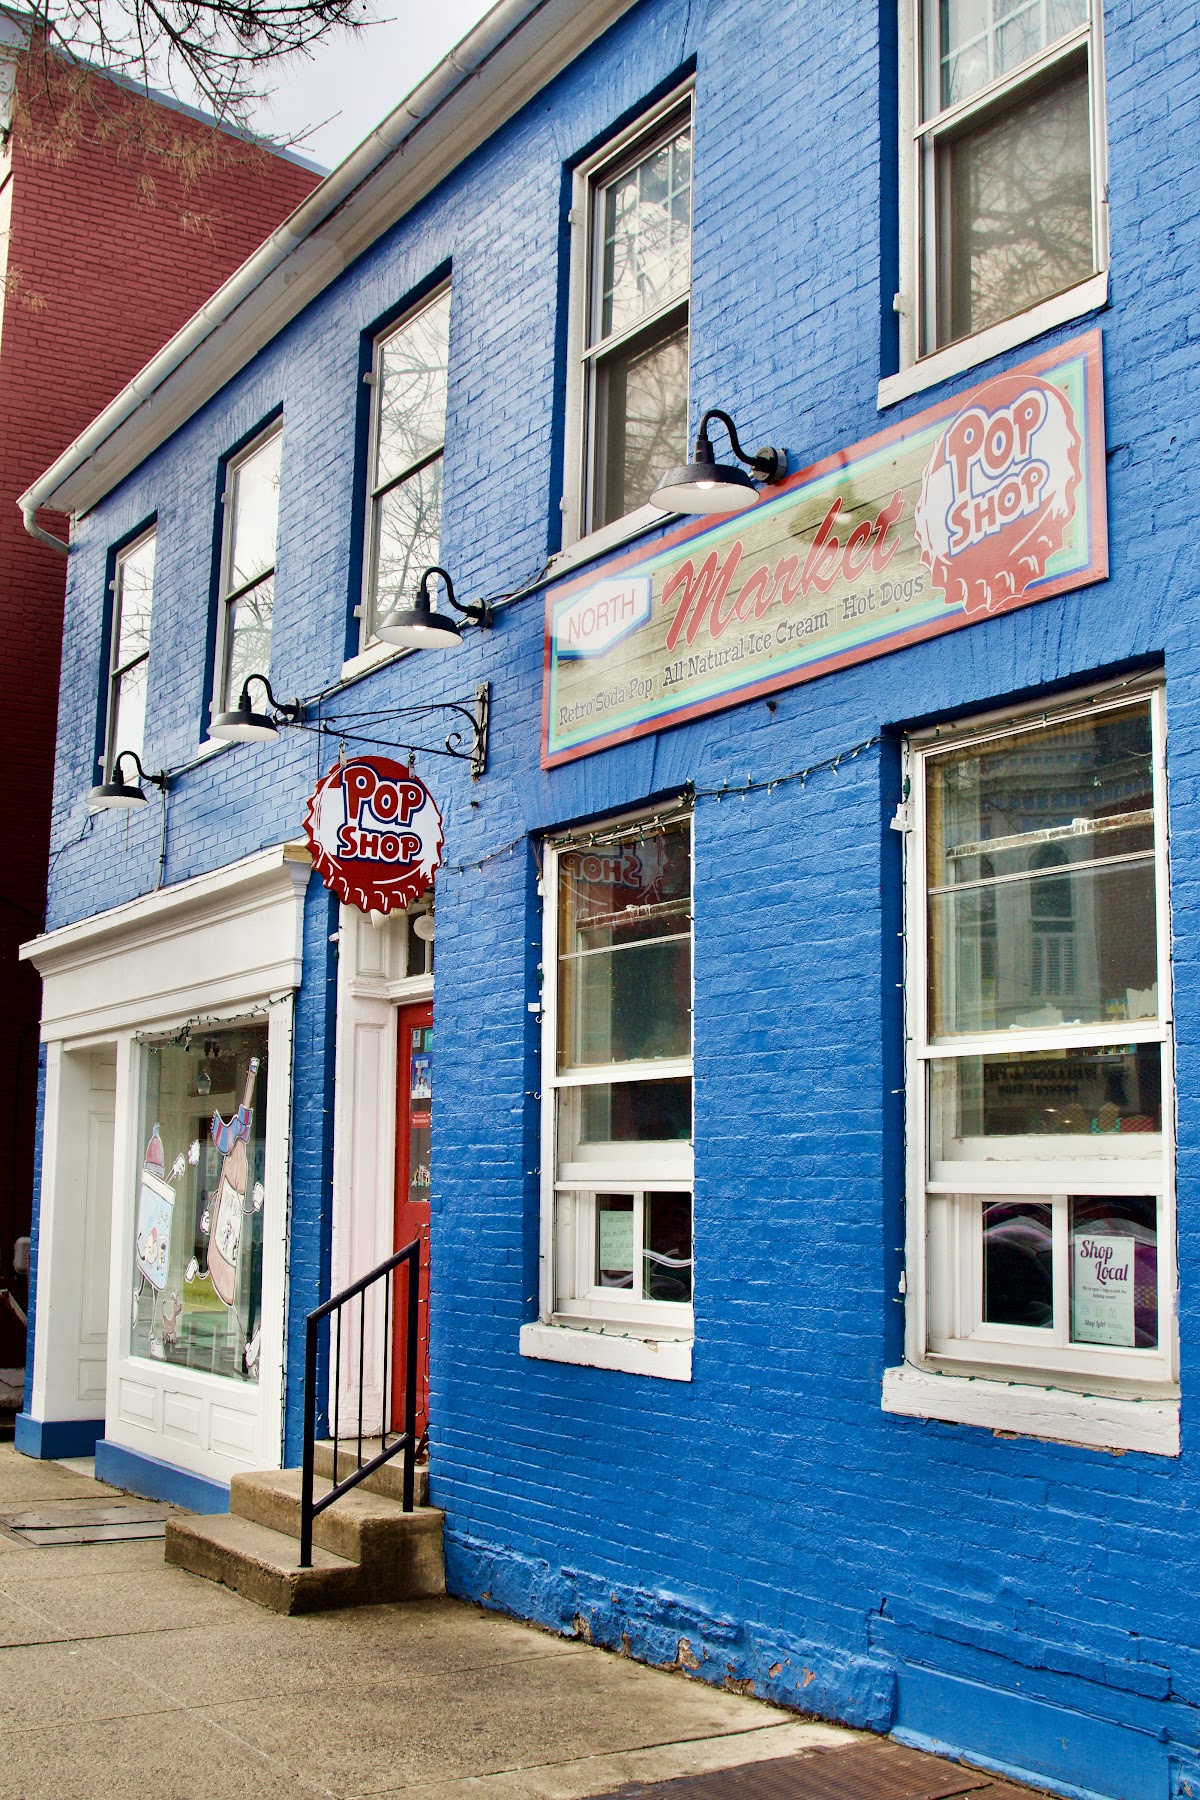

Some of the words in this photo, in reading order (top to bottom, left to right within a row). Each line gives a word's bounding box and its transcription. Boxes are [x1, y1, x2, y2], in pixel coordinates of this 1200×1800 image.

[948, 396, 1041, 494] POP
[951, 465, 1043, 549] SHOP
[567, 588, 635, 643] NORTH
[660, 489, 905, 653] Market
[559, 700, 593, 727] Retro
[595, 685, 626, 713] Soda
[628, 677, 653, 703] Pop
[662, 660, 684, 687] All
[687, 638, 745, 678] Natural
[748, 631, 772, 655] Ice
[775, 611, 829, 645] Cream
[842, 587, 876, 620] Hot
[879, 574, 925, 607] Dogs
[343, 766, 423, 822] POP
[339, 825, 420, 863] SHOP
[1080, 1239, 1113, 1264] Shop
[1095, 1261, 1129, 1285] Local
